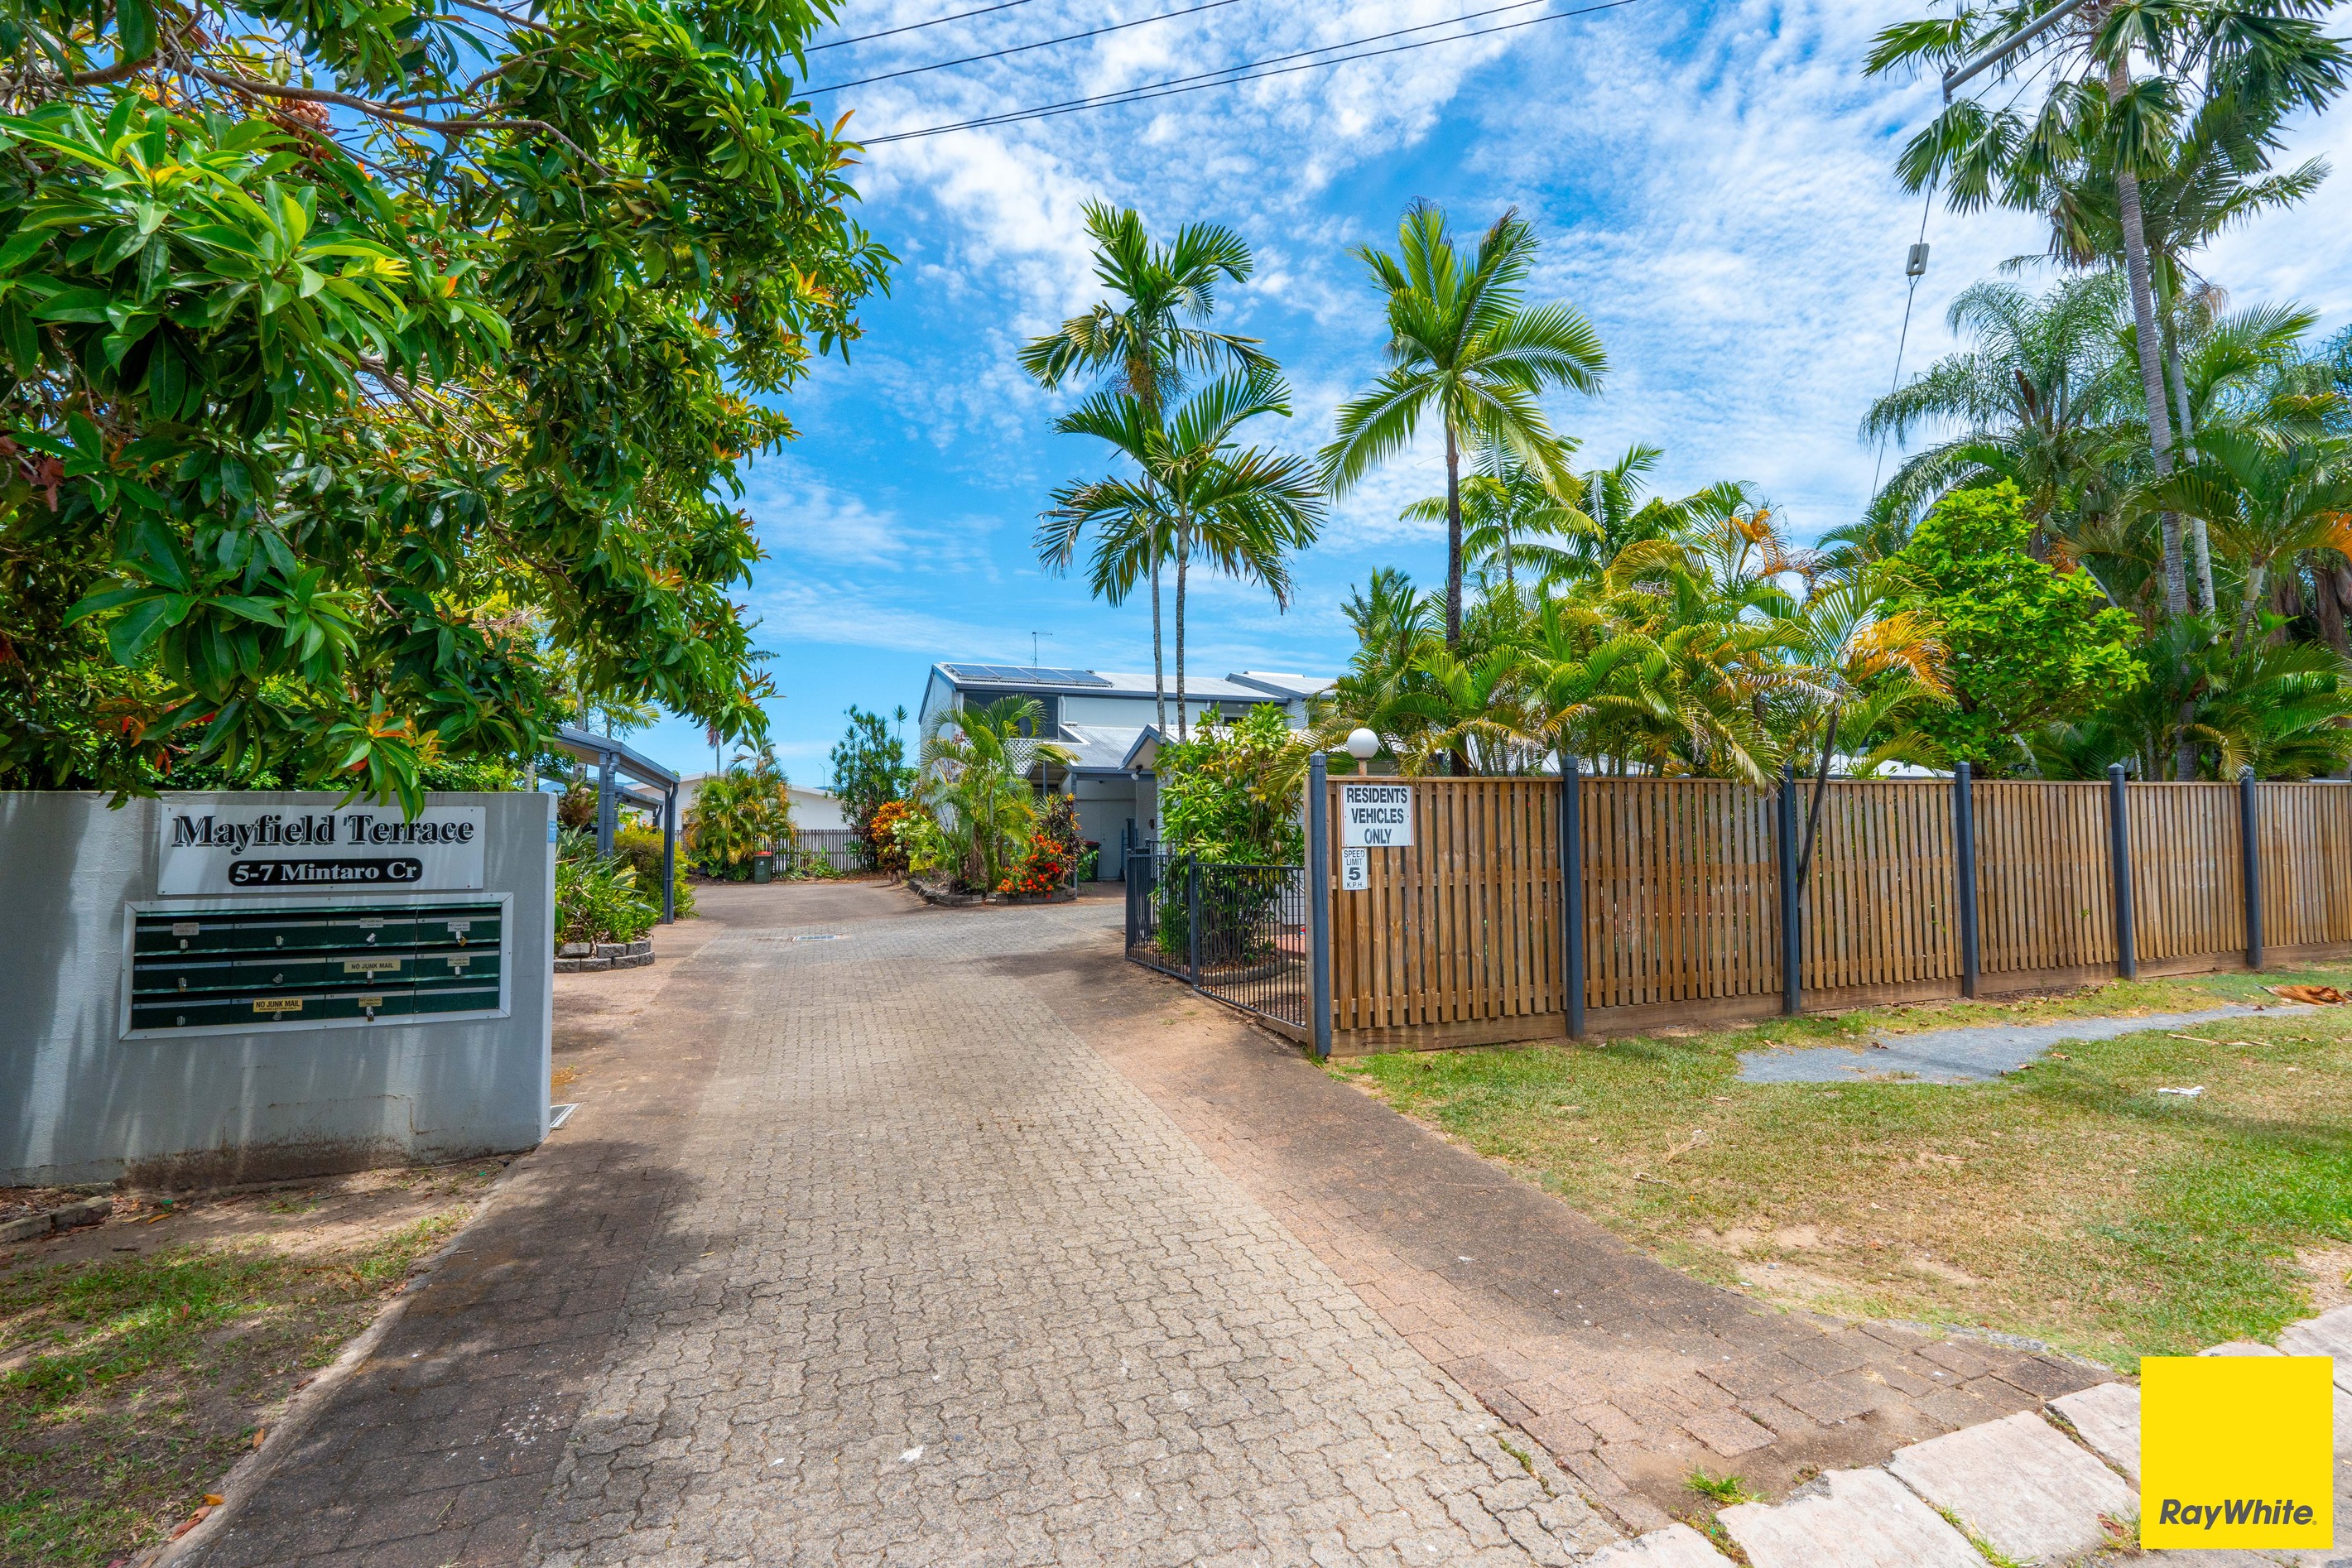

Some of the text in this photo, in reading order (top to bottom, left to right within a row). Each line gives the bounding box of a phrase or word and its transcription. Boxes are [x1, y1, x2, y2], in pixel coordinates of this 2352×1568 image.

[1347, 787, 1407, 804] RESIDENTS
[1351, 808, 1404, 824] VEHICLES
[171, 815, 474, 855] Mayfield Terrace
[1364, 828, 1392, 844] ONLY
[1344, 849, 1365, 858] SPEED
[235, 862, 416, 882] 5-7 Mintaro Cr
[1348, 867, 1361, 881] 5
